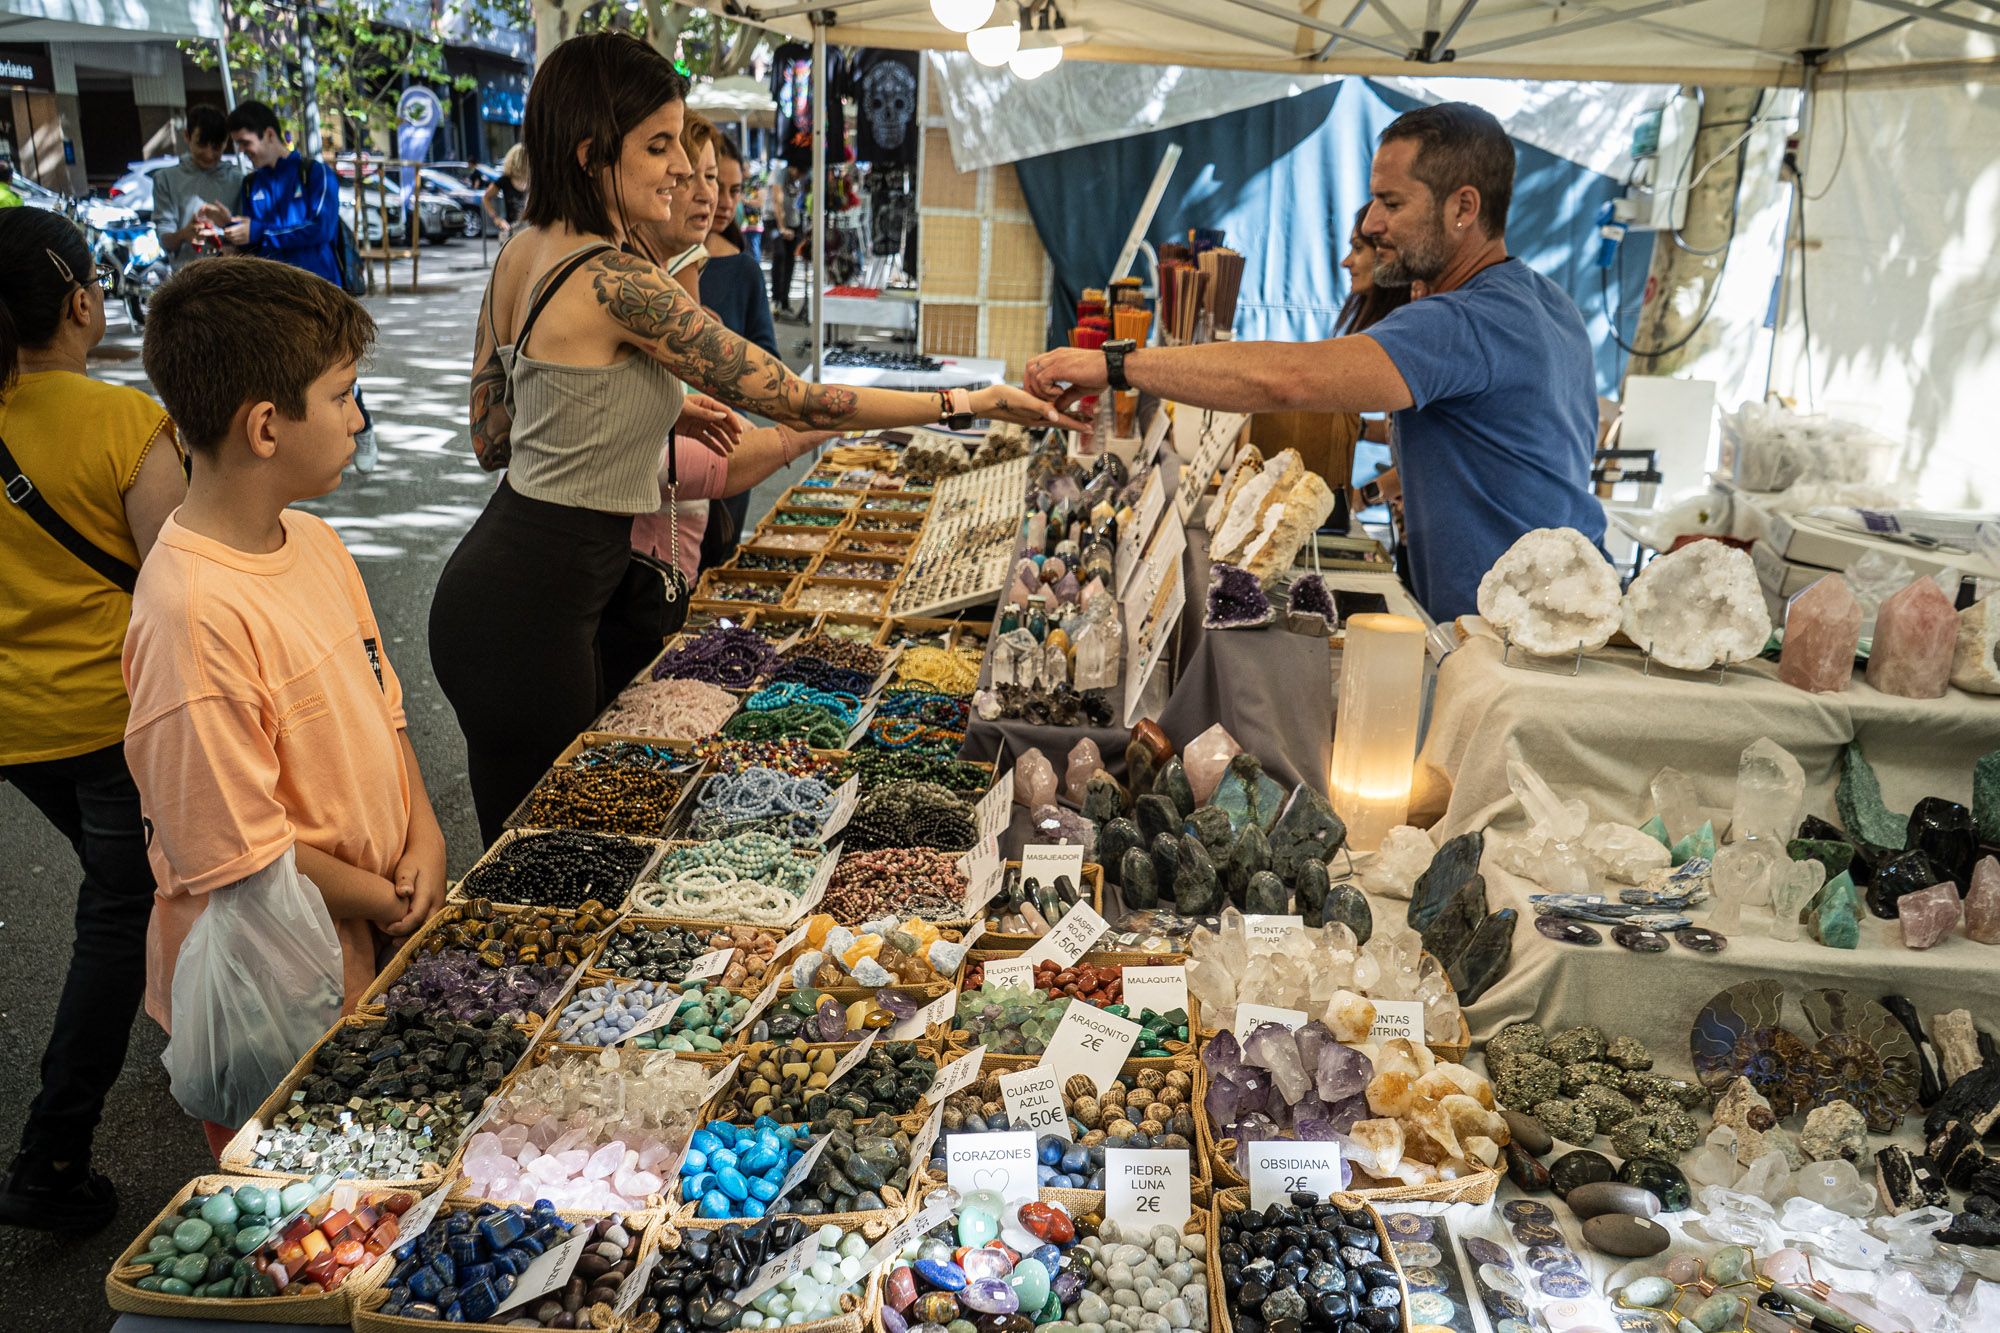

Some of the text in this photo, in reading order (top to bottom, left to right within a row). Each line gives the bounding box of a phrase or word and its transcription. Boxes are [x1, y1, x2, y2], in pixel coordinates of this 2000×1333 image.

[1066, 922, 1086, 943] ROJO
[1072, 915, 1096, 936] JASPE
[1051, 930, 1082, 960] 1,50€
[986, 965, 1031, 976] FLUORITA
[1000, 975, 1019, 987] 2€
[1127, 976, 1183, 984] MALAQUITA
[1069, 1013, 1130, 1043] ARAGONITO
[1369, 1026, 1410, 1037] ITRINO
[1080, 1033, 1104, 1052] 2€
[932, 1077, 947, 1094] 2€
[1006, 1079, 1054, 1098] CUARZO
[1019, 1095, 1049, 1109] AZUL
[952, 1148, 1031, 1162] CORAZONES
[1124, 1165, 1172, 1176] PIEDRA
[1260, 1158, 1330, 1170] OBSIDIANA
[1131, 1179, 1166, 1190] LUNA
[1284, 1176, 1308, 1193] 2€
[1136, 1195, 1161, 1213] 2€
[770, 1259, 788, 1279] 2€
